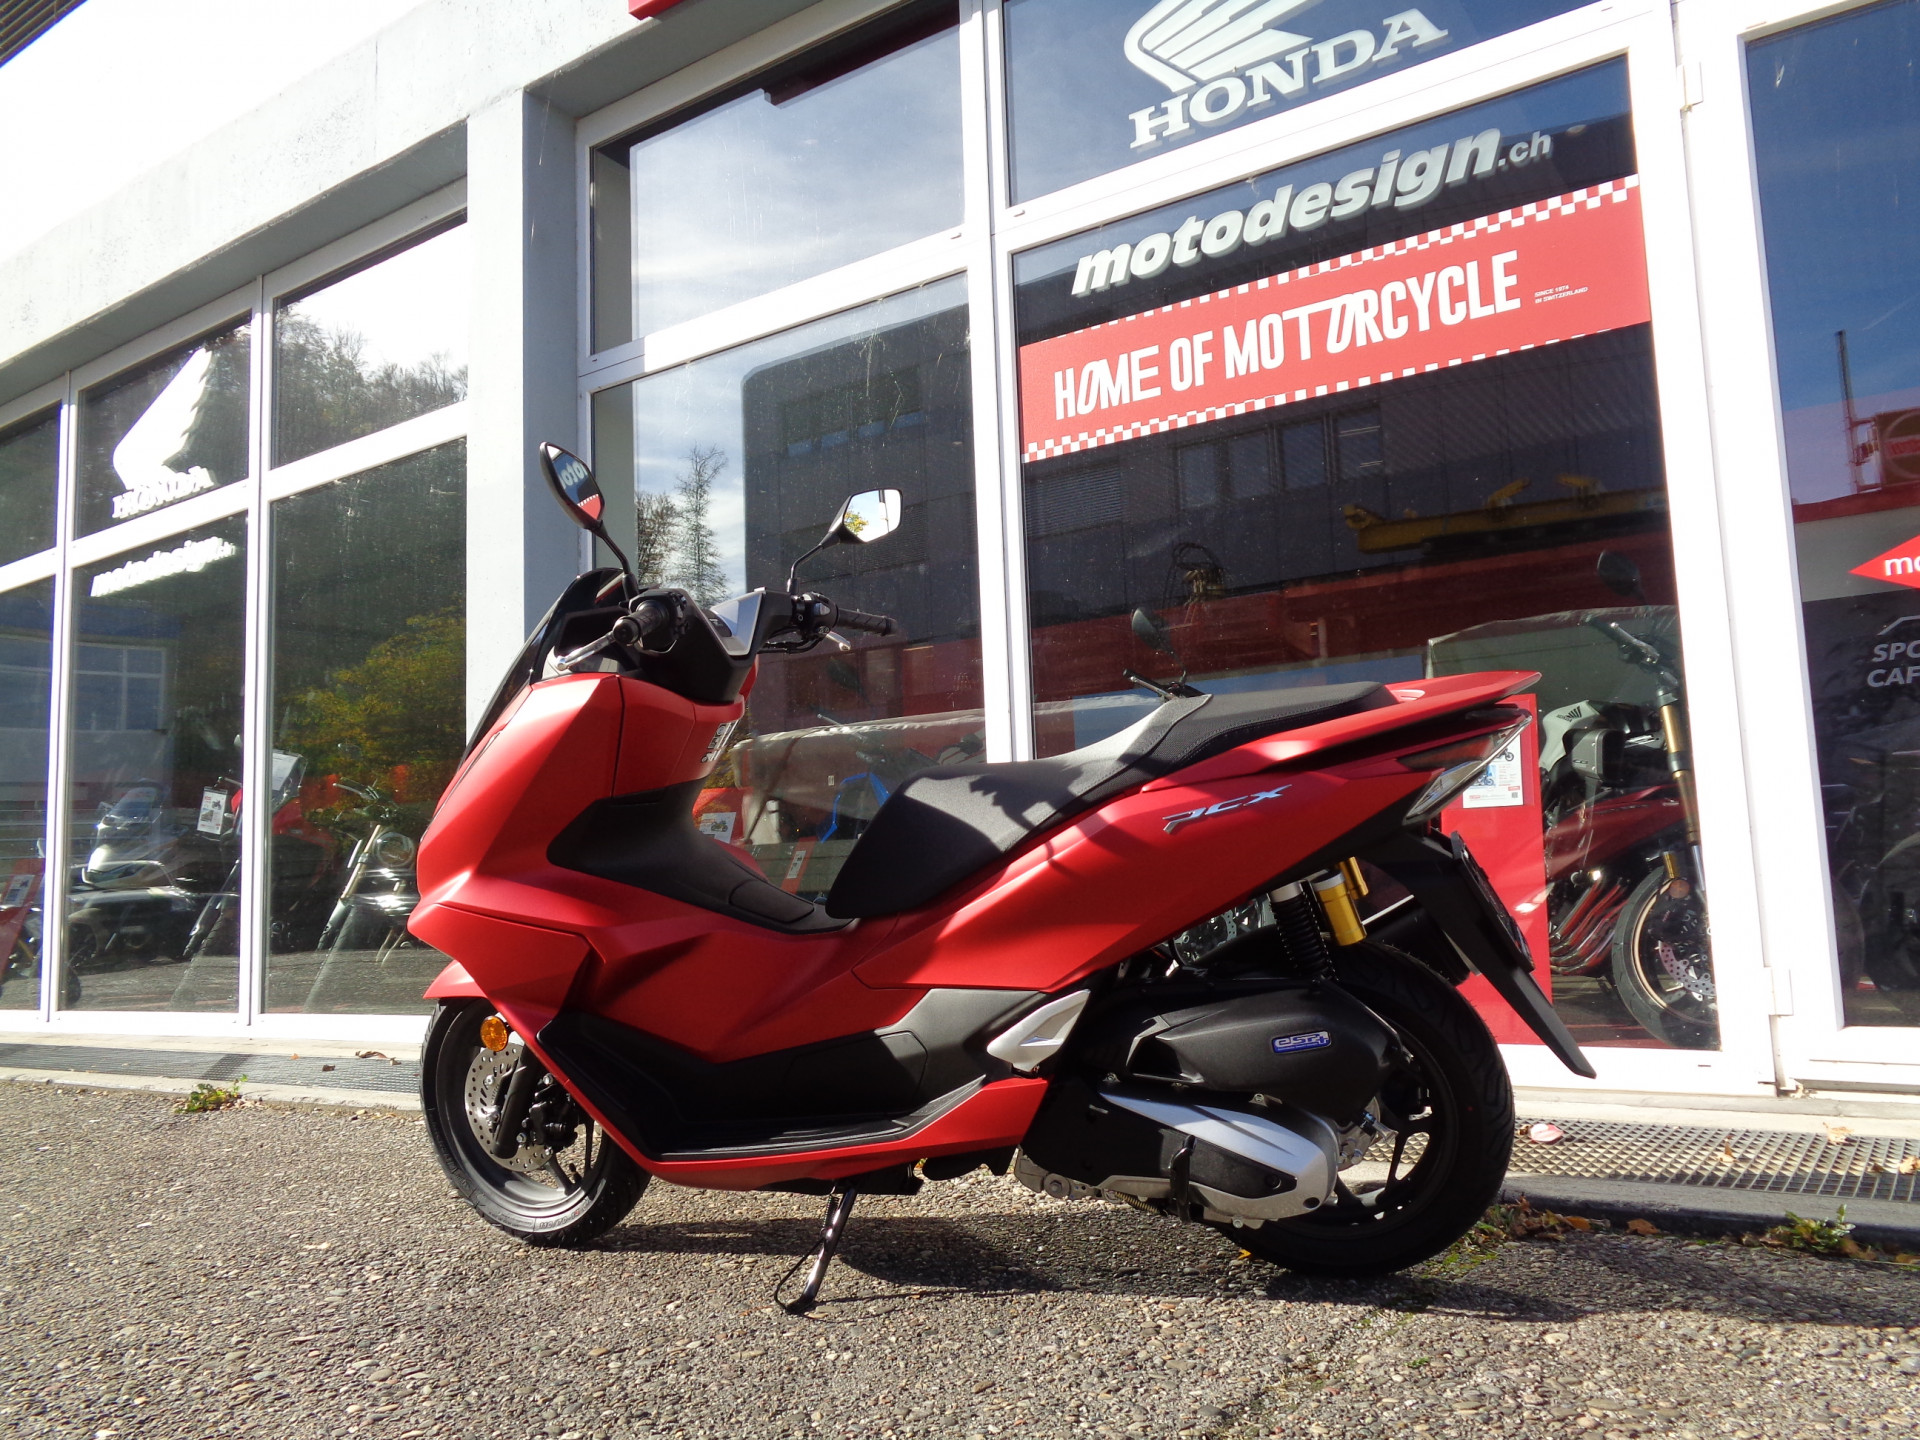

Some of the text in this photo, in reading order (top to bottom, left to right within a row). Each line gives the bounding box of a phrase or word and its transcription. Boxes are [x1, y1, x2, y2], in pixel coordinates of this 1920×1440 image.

[1129, 8, 1449, 149] HONDA
[1054, 250, 1521, 420] HOME OF MOTORCYCLE
